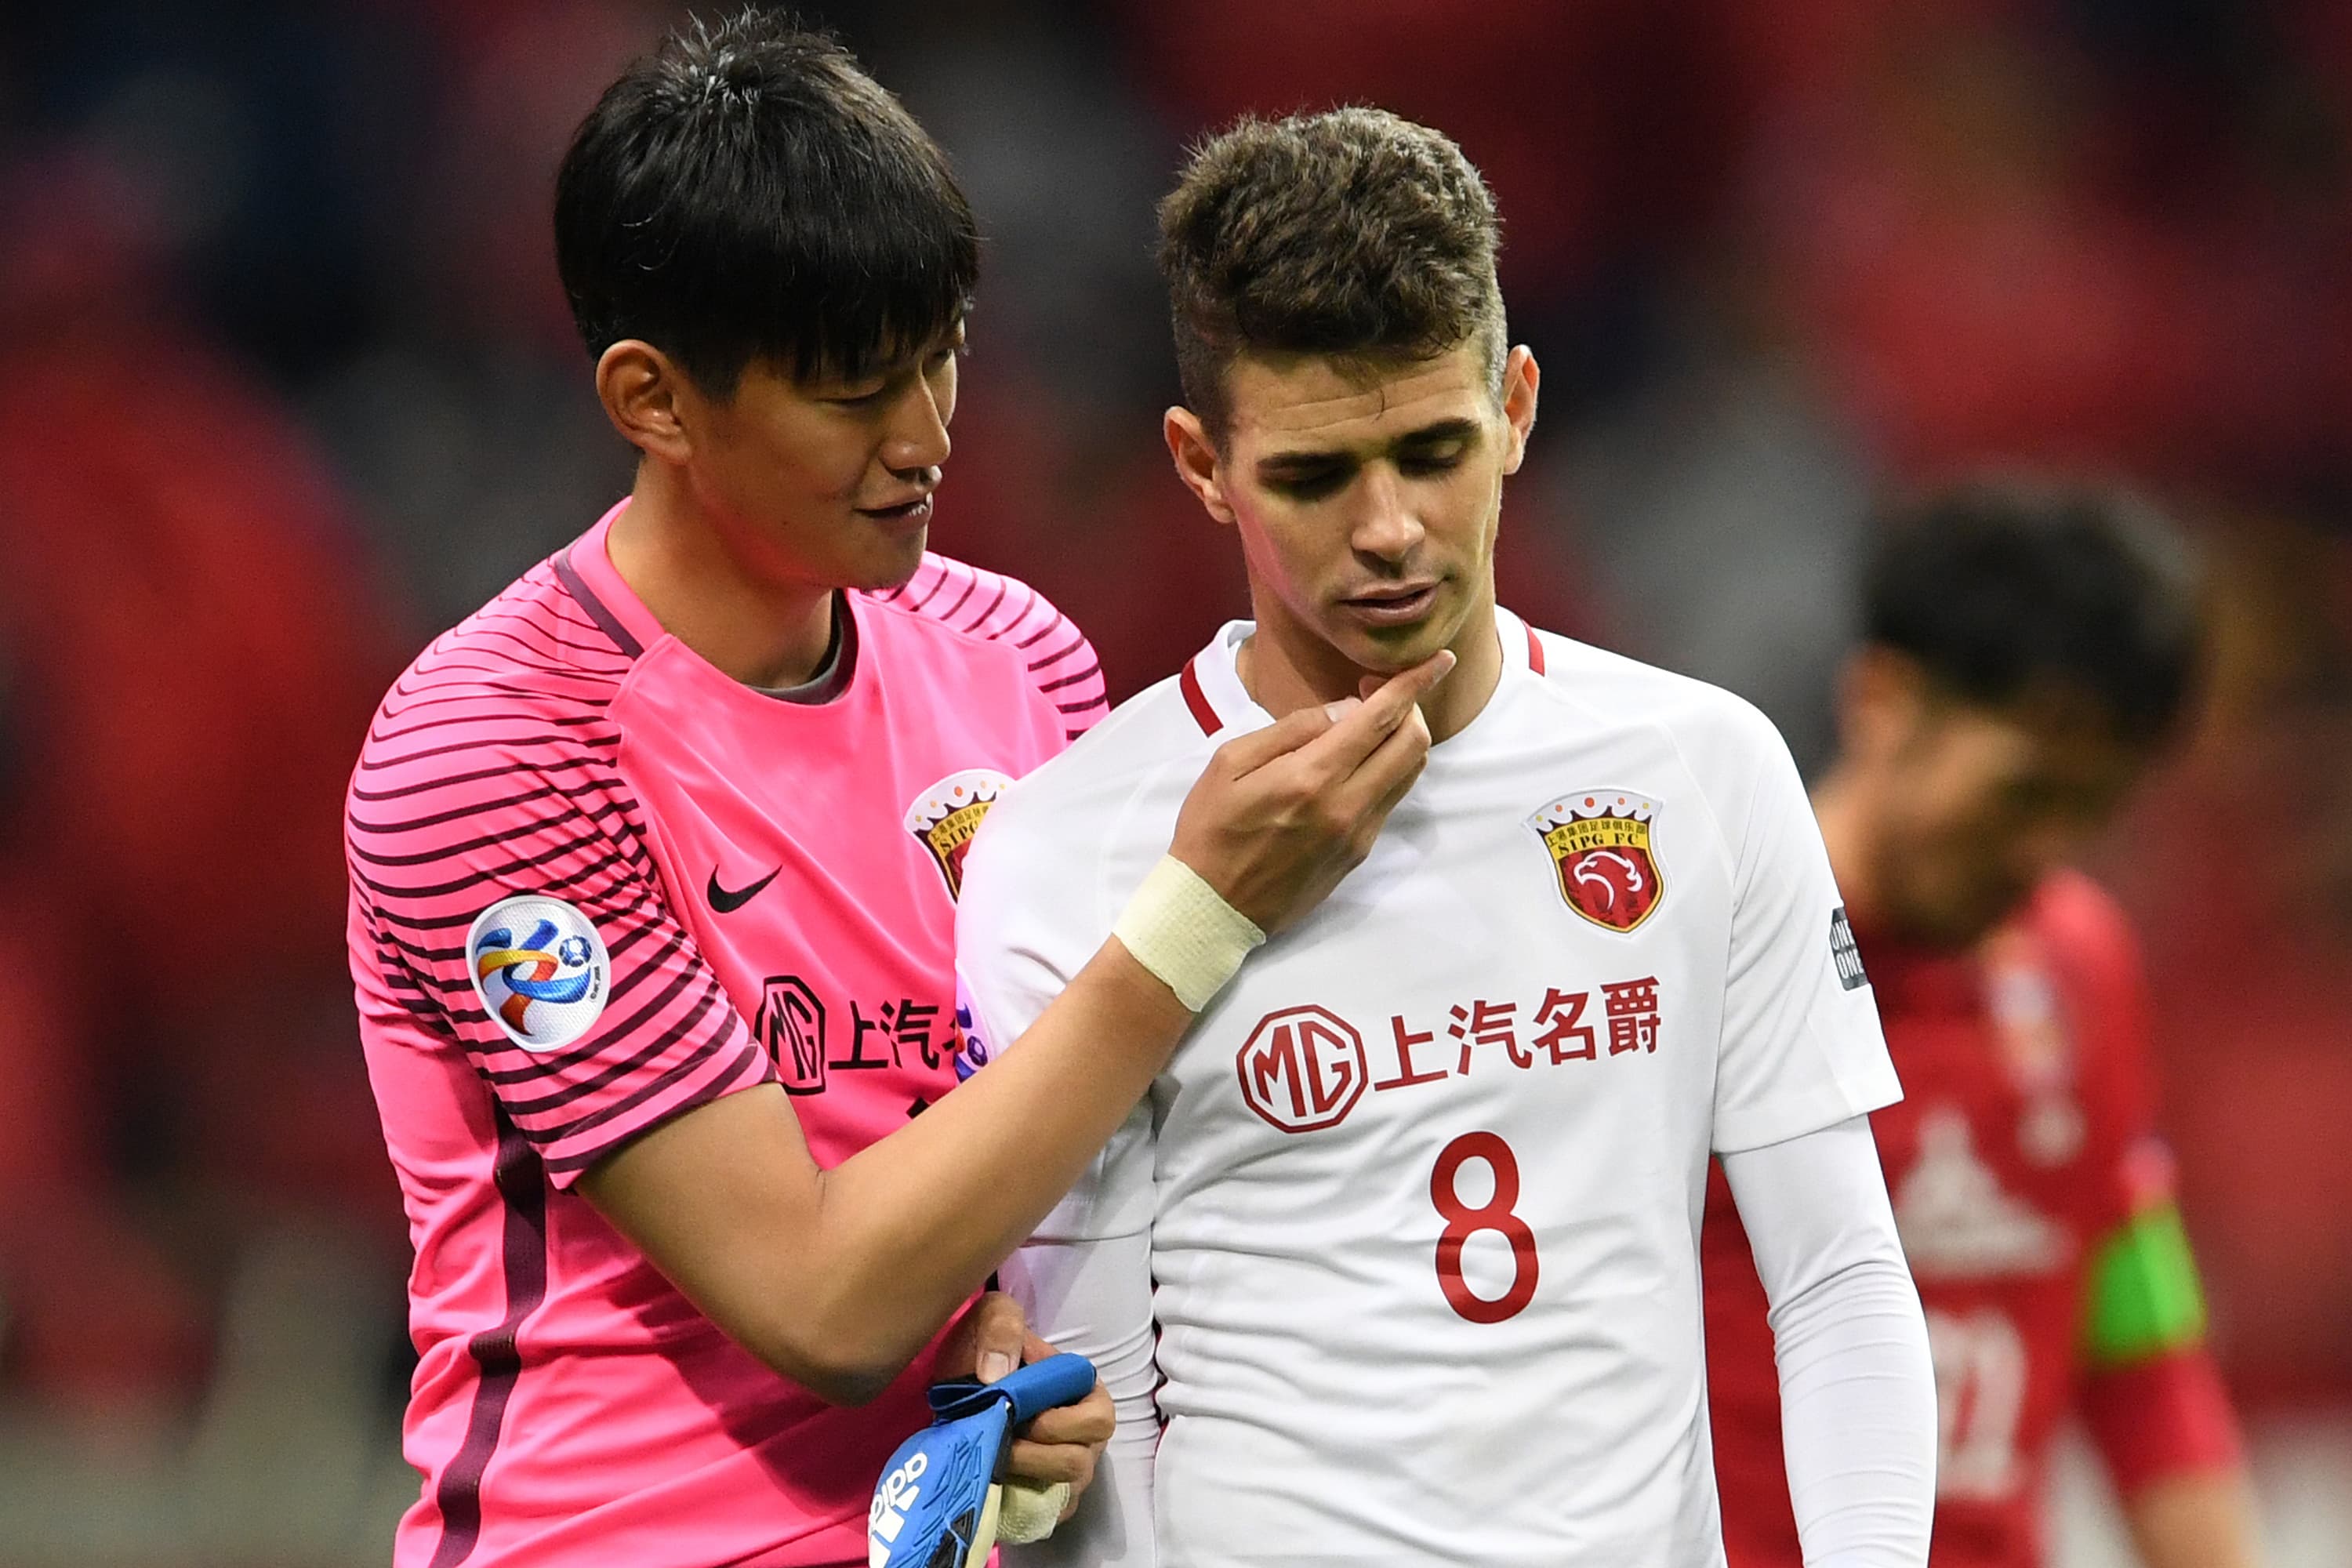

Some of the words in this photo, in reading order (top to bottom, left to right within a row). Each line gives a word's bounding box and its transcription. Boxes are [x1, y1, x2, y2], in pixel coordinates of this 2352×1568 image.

[1558, 835, 1604, 855] SIPG
[1614, 833, 1639, 845] FC
[767, 990, 818, 1081] MG
[828, 999, 956, 1070] 上汽
[1254, 1021, 1352, 1118] MG
[1374, 976, 1661, 1091] 上汽名爵
[1430, 1131, 1539, 1324] 8
